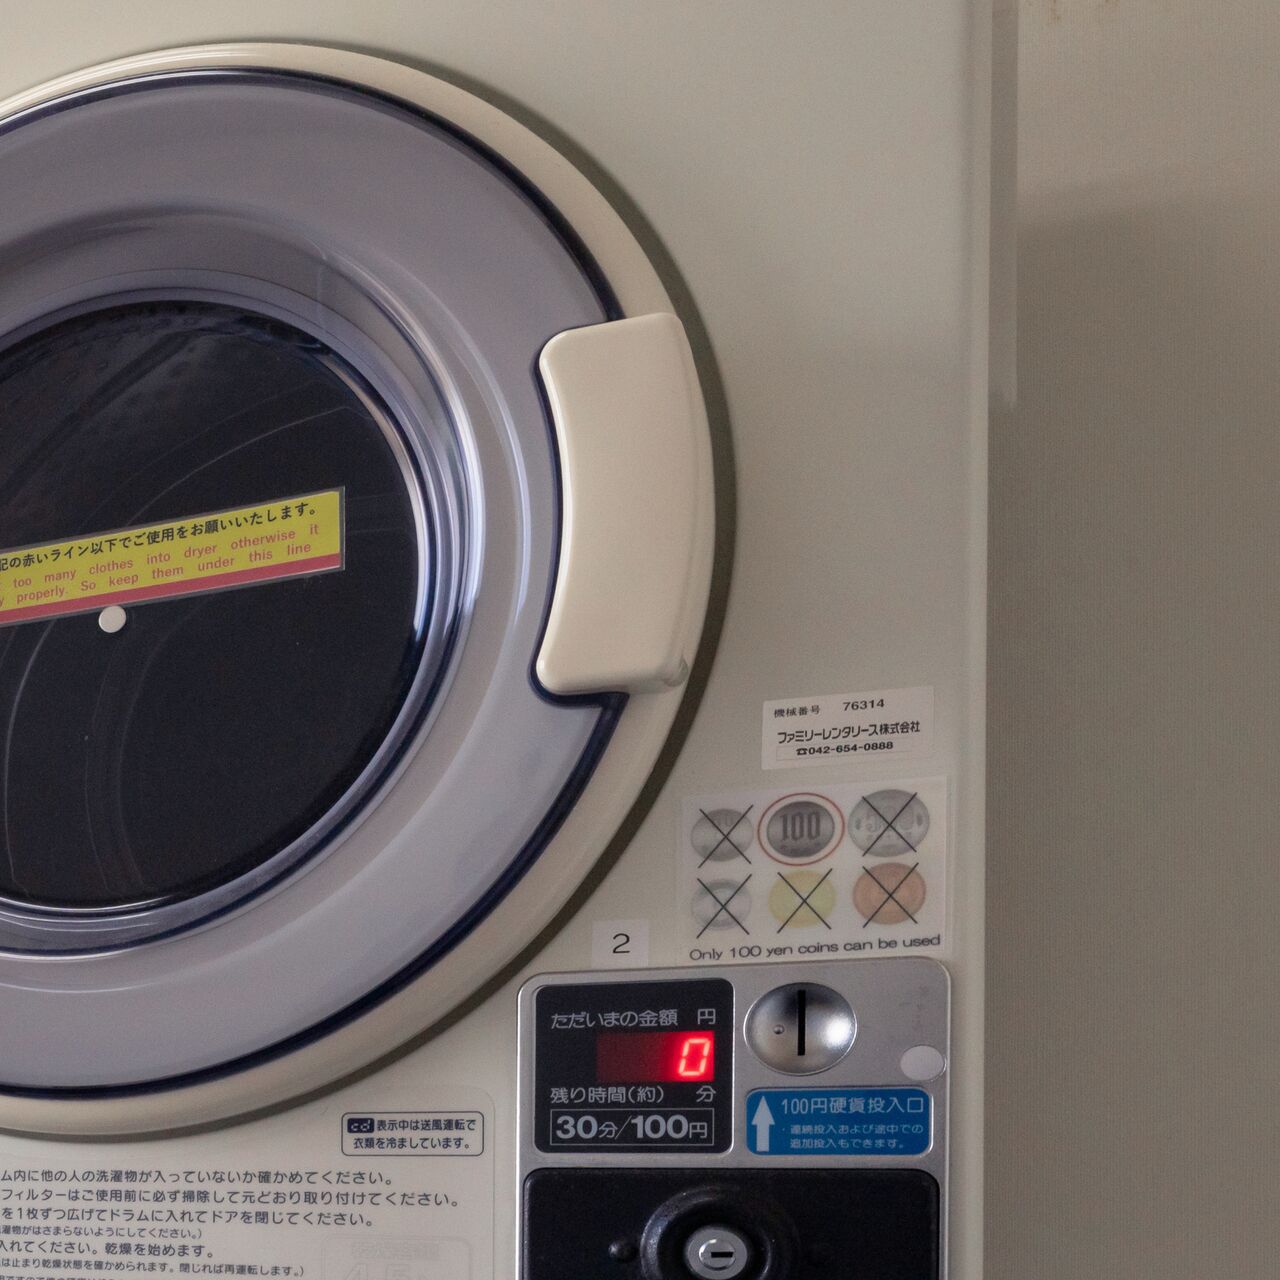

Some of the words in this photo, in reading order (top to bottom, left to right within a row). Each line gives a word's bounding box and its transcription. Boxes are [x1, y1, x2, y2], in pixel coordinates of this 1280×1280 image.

[13, 577, 32, 588] too
[45, 569, 76, 583] many
[89, 559, 133, 574] clothes
[147, 553, 170, 564] into
[184, 545, 217, 559] dryer
[231, 530, 296, 550] otherwise
[310, 524, 318, 535] it
[17, 586, 68, 604] properly.
[81, 581, 96, 591] So
[109, 573, 139, 587] keep
[152, 565, 183, 579] them
[198, 557, 235, 571] under
[249, 550, 272, 562] this
[288, 543, 311, 555] line
[774, 706, 820, 718] 機械番号
[843, 699, 884, 711] 76314
[778, 721, 920, 743] ファミリーレンタリース株式会社
[809, 742, 893, 755] 042-654-0888
[780, 811, 820, 841] 100
[613, 933, 630, 953] 2
[690, 949, 722, 961] Only
[731, 946, 761, 958] 100
[766, 946, 792, 956] yen
[798, 941, 838, 954] coins
[844, 940, 872, 950] can
[878, 937, 897, 948] be
[903, 934, 940, 947] used
[551, 1010, 678, 1029] ただいまの金額
[698, 1009, 716, 1025] 円
[678, 1037, 711, 1076] 0
[551, 1086, 664, 1104] 残り時間(約)
[696, 1086, 716, 1102] 分
[781, 1097, 924, 1114] 100円硬貨投入口
[377, 1119, 476, 1131] 表示中は送風運転で
[556, 1113, 708, 1140] 30分/100円
[353, 1137, 471, 1149] 衣類を冷ましています。
